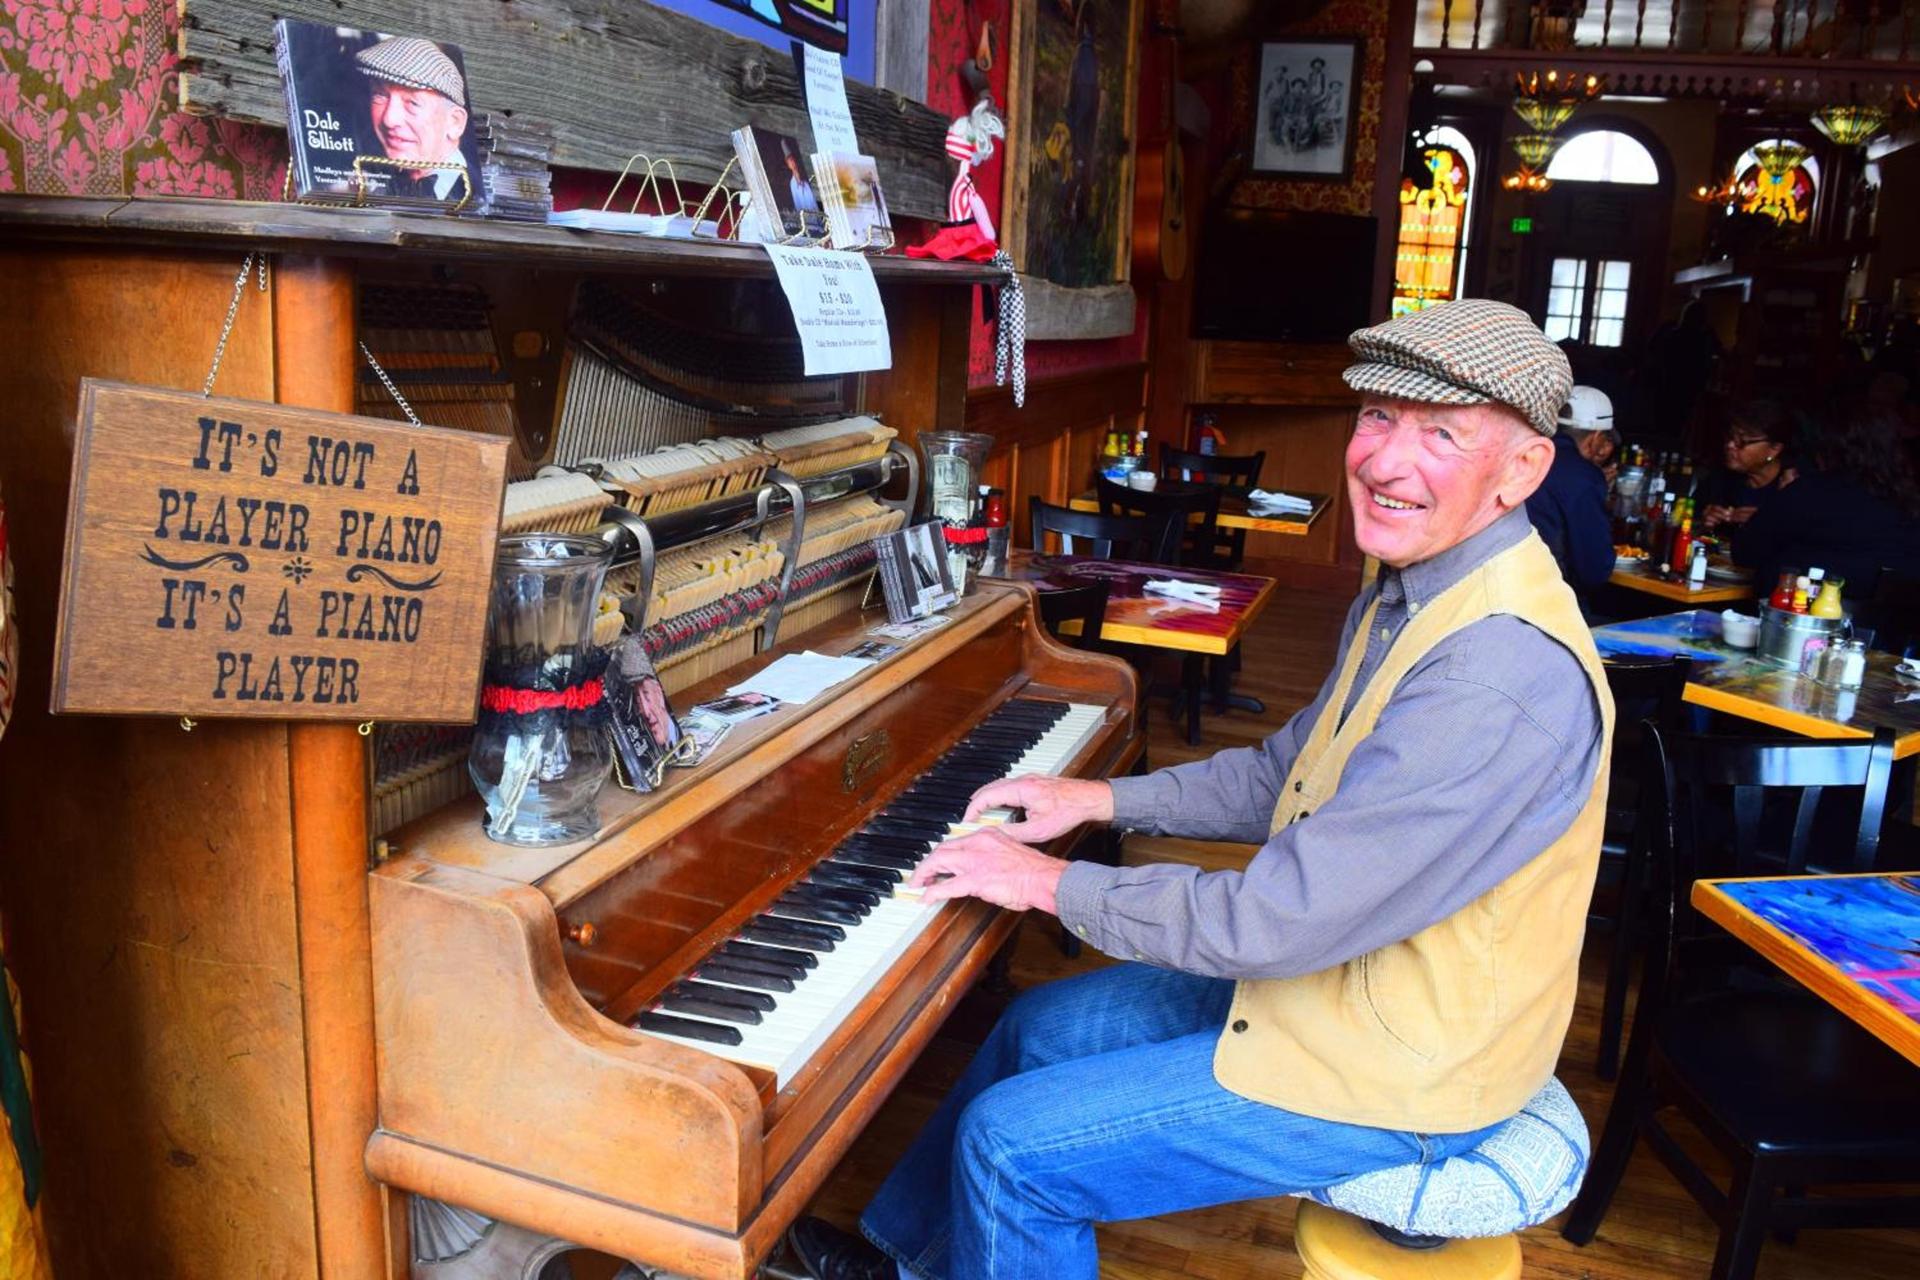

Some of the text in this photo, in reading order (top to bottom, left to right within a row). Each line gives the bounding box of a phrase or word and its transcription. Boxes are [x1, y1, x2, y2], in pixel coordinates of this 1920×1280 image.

[303, 109, 340, 131] Dale
[308, 130, 354, 152] Elliott
[1512, 217, 1532, 233] EXIT
[781, 254, 805, 267] Take
[804, 255, 825, 268] Dale
[193, 417, 420, 496] IT'S NOT A
[154, 487, 442, 566] PLAYER PIANO
[156, 578, 424, 643] IT'S A PIANO
[212, 651, 360, 704] PLAYER
